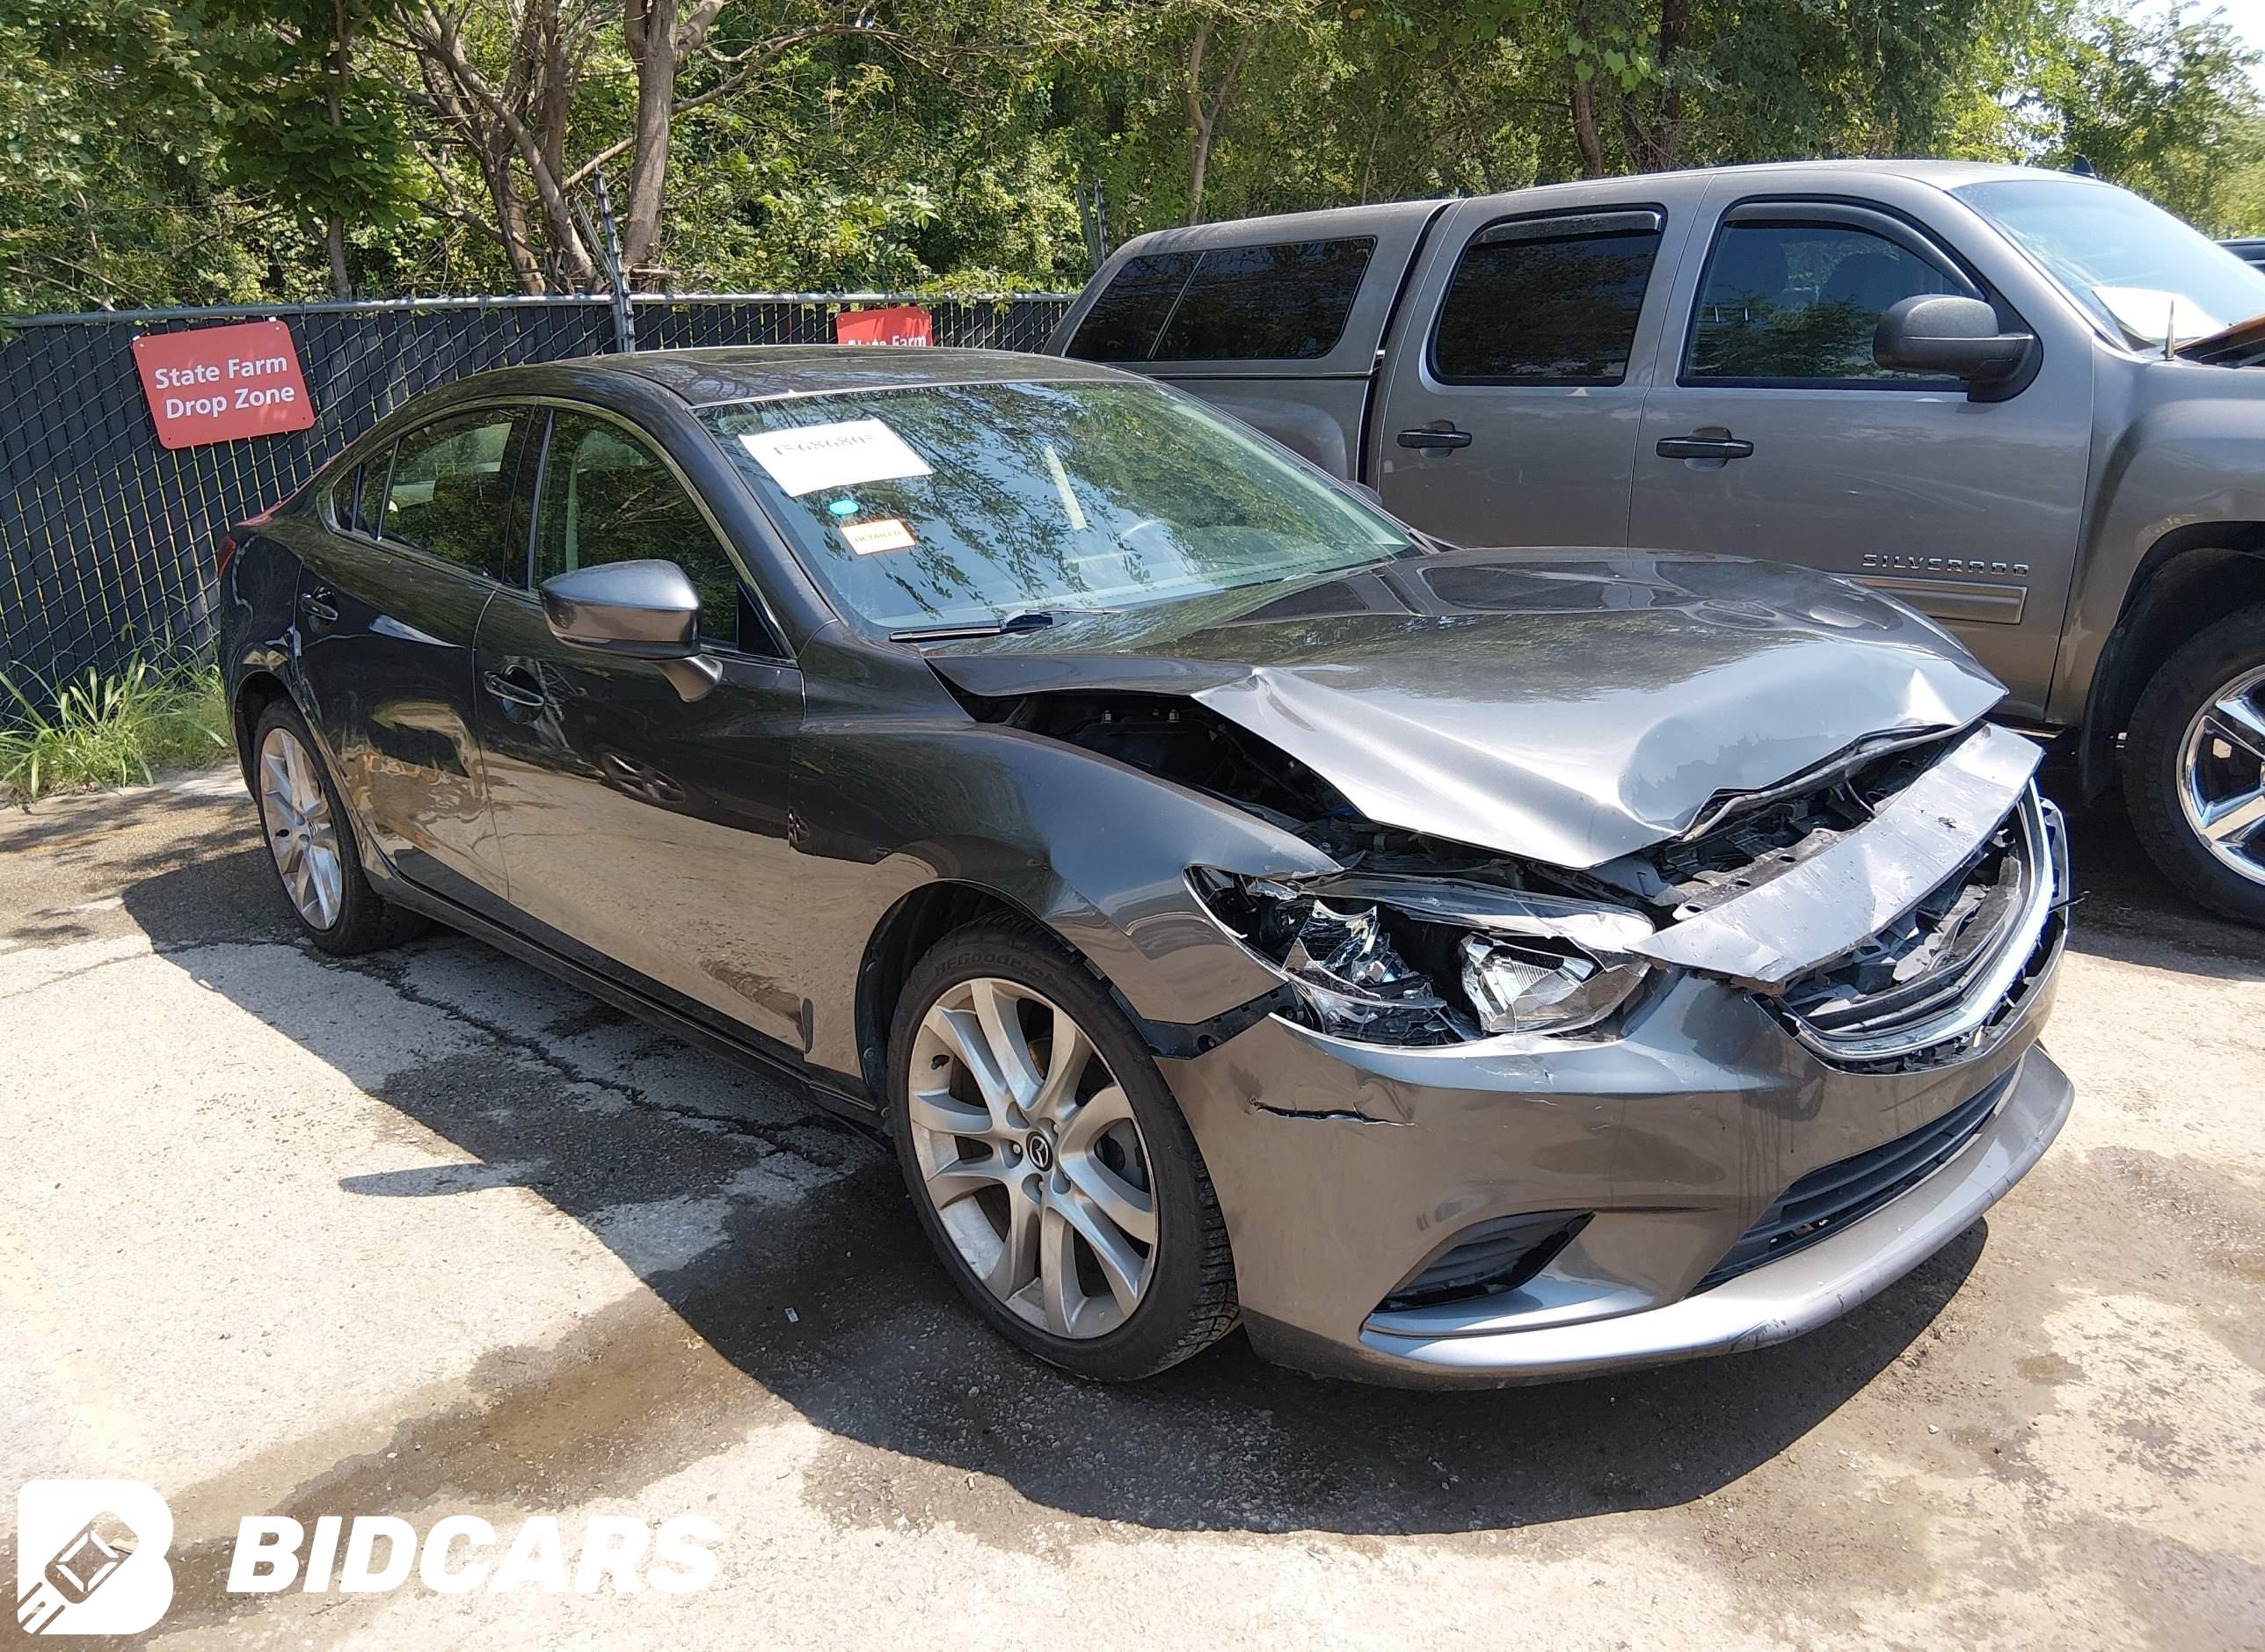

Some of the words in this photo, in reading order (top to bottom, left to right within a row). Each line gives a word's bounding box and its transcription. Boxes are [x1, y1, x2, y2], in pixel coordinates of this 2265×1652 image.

[155, 365, 220, 389] State
[228, 356, 288, 379] Farm
[165, 396, 227, 419] Drop
[235, 385, 295, 409] Zone
[1862, 553, 2029, 577] SILVERADO
